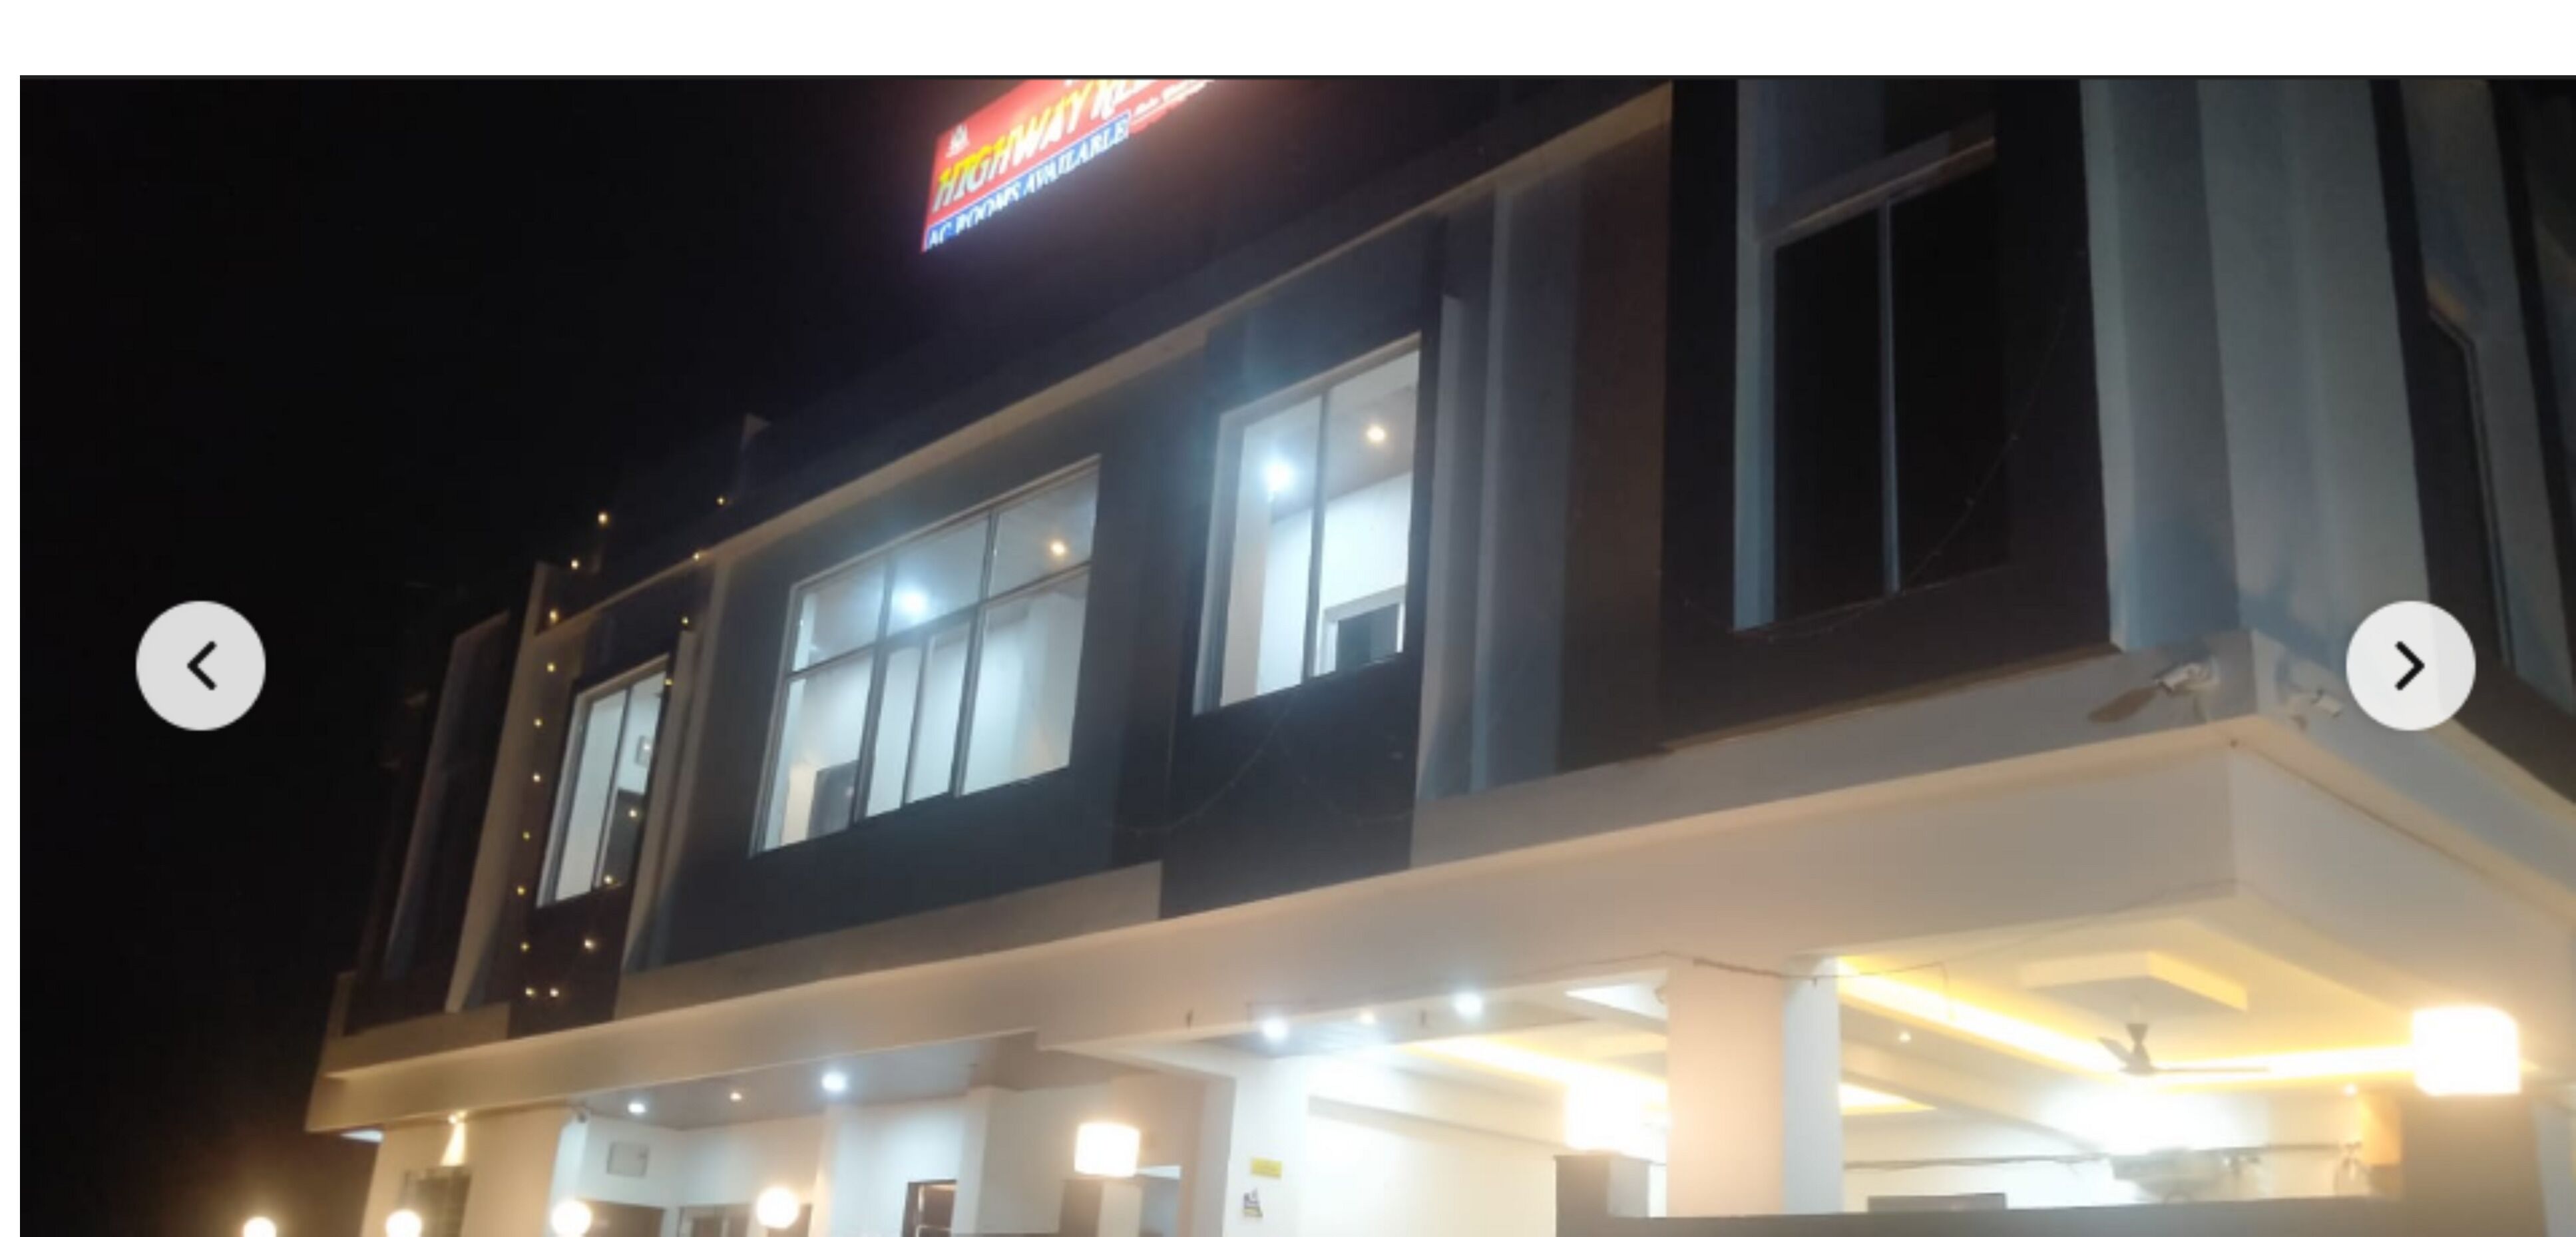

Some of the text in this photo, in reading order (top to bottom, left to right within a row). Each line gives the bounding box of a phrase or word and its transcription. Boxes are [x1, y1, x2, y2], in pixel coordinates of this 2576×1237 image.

[933, 80, 1093, 212] HIGHWAY
[955, 181, 1021, 234] ROOMS
[1023, 118, 1127, 196] AVAILABLE
